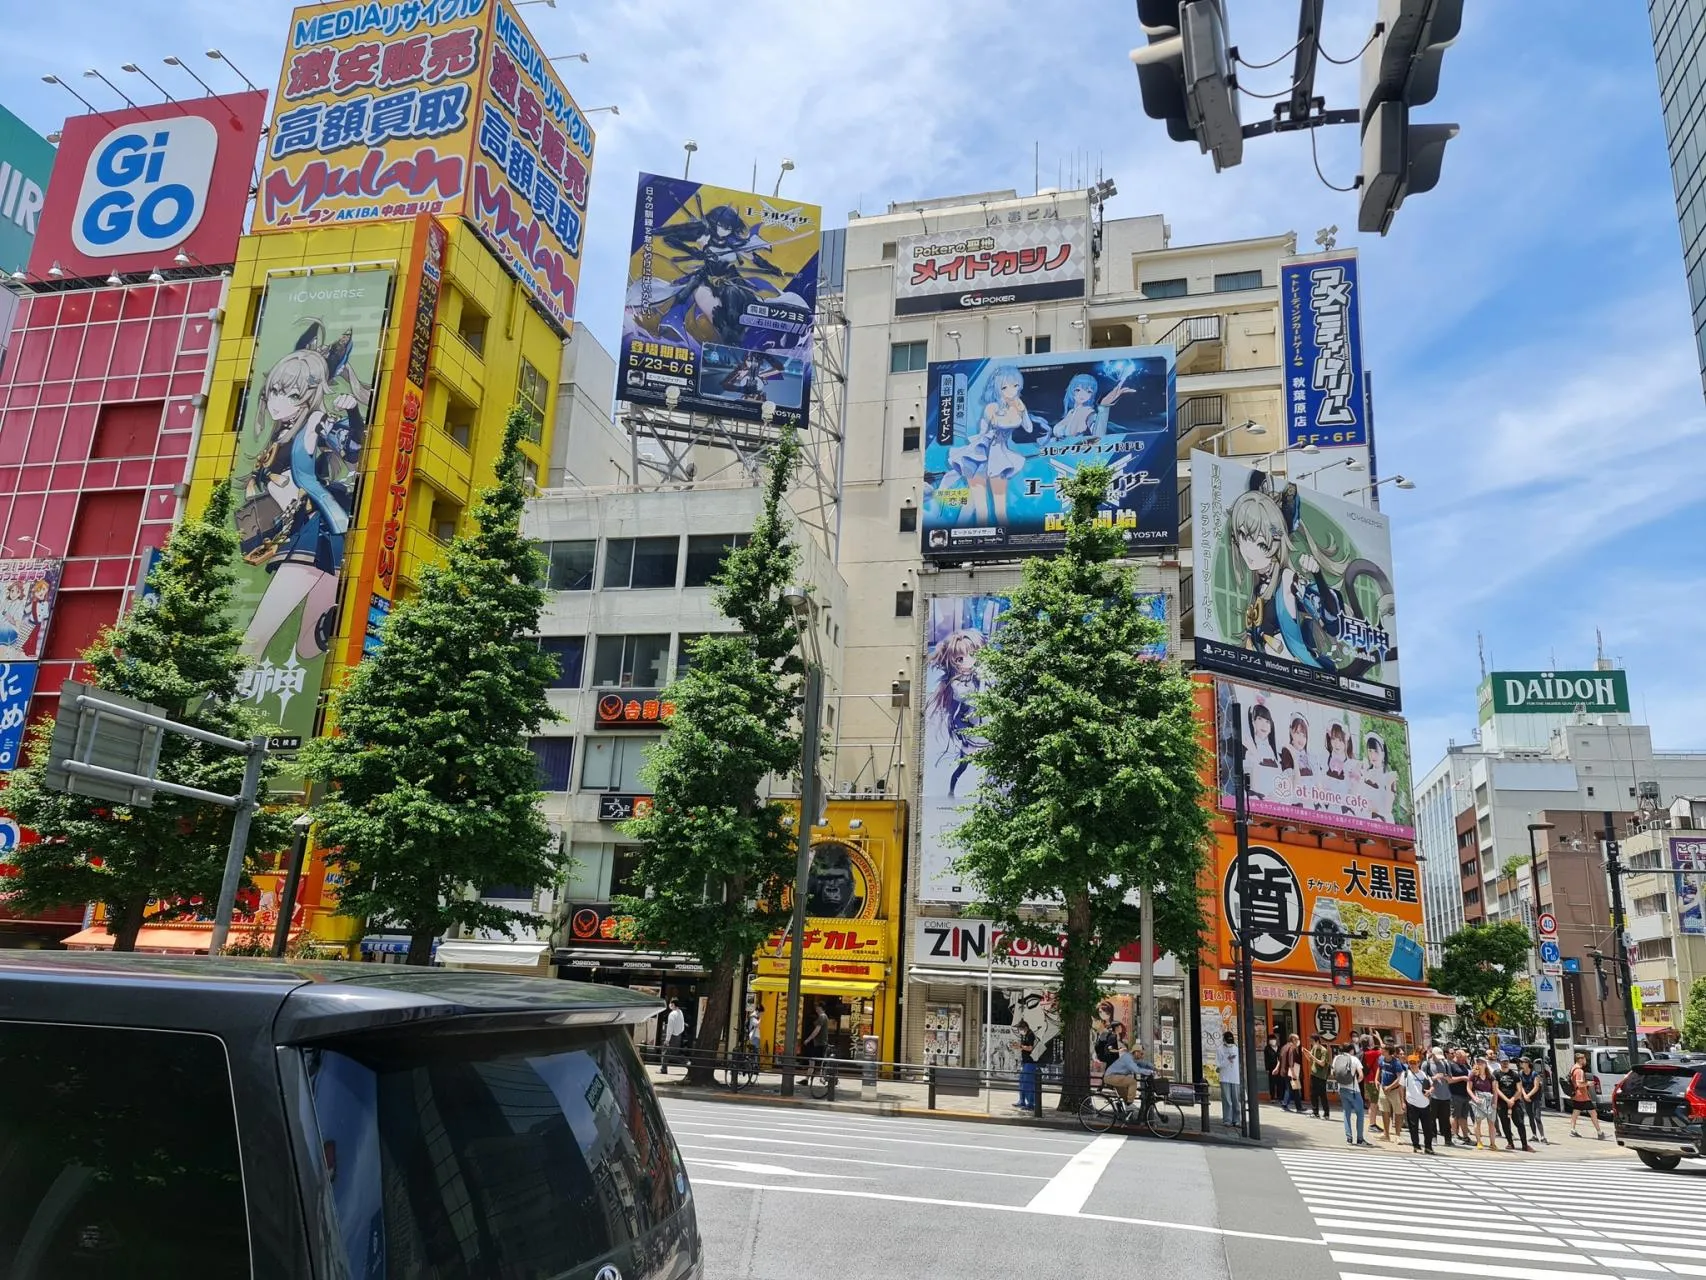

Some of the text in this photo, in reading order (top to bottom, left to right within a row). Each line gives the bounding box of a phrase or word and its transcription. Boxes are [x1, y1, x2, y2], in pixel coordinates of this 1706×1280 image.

[286, 28, 477, 97] 激安販売
[272, 85, 467, 155] 高額買取
[491, 44, 587, 203] 激安販売
[264, 148, 463, 224] Mulan
[481, 103, 580, 252] 高額買取
[278, 200, 443, 227] ムーラン AKIBA 中央通り店
[474, 162, 575, 317] Mulan
[914, 237, 995, 258] Pokerの聖地
[512, 259, 537, 290] AKIBA
[911, 244, 1072, 285] メイドカジノ
[422, 276, 438, 295] DVD
[419, 313, 430, 327] CD
[1292, 377, 1308, 427] 秋葉原店
[1132, 531, 1168, 539] YOSTAR
[1265, 660, 1290, 673] Windows
[1346, 795, 1368, 808] cafe
[1306, 878, 1340, 894] チケット
[1342, 860, 1419, 904] 大黒屋
[1234, 863, 1298, 950] 質
[924, 920, 951, 929] COMIC
[1543, 919, 1553, 929] 40
[924, 923, 986, 962] ZIN
[1545, 947, 1553, 959] P
[1316, 1007, 1340, 1038] 質
